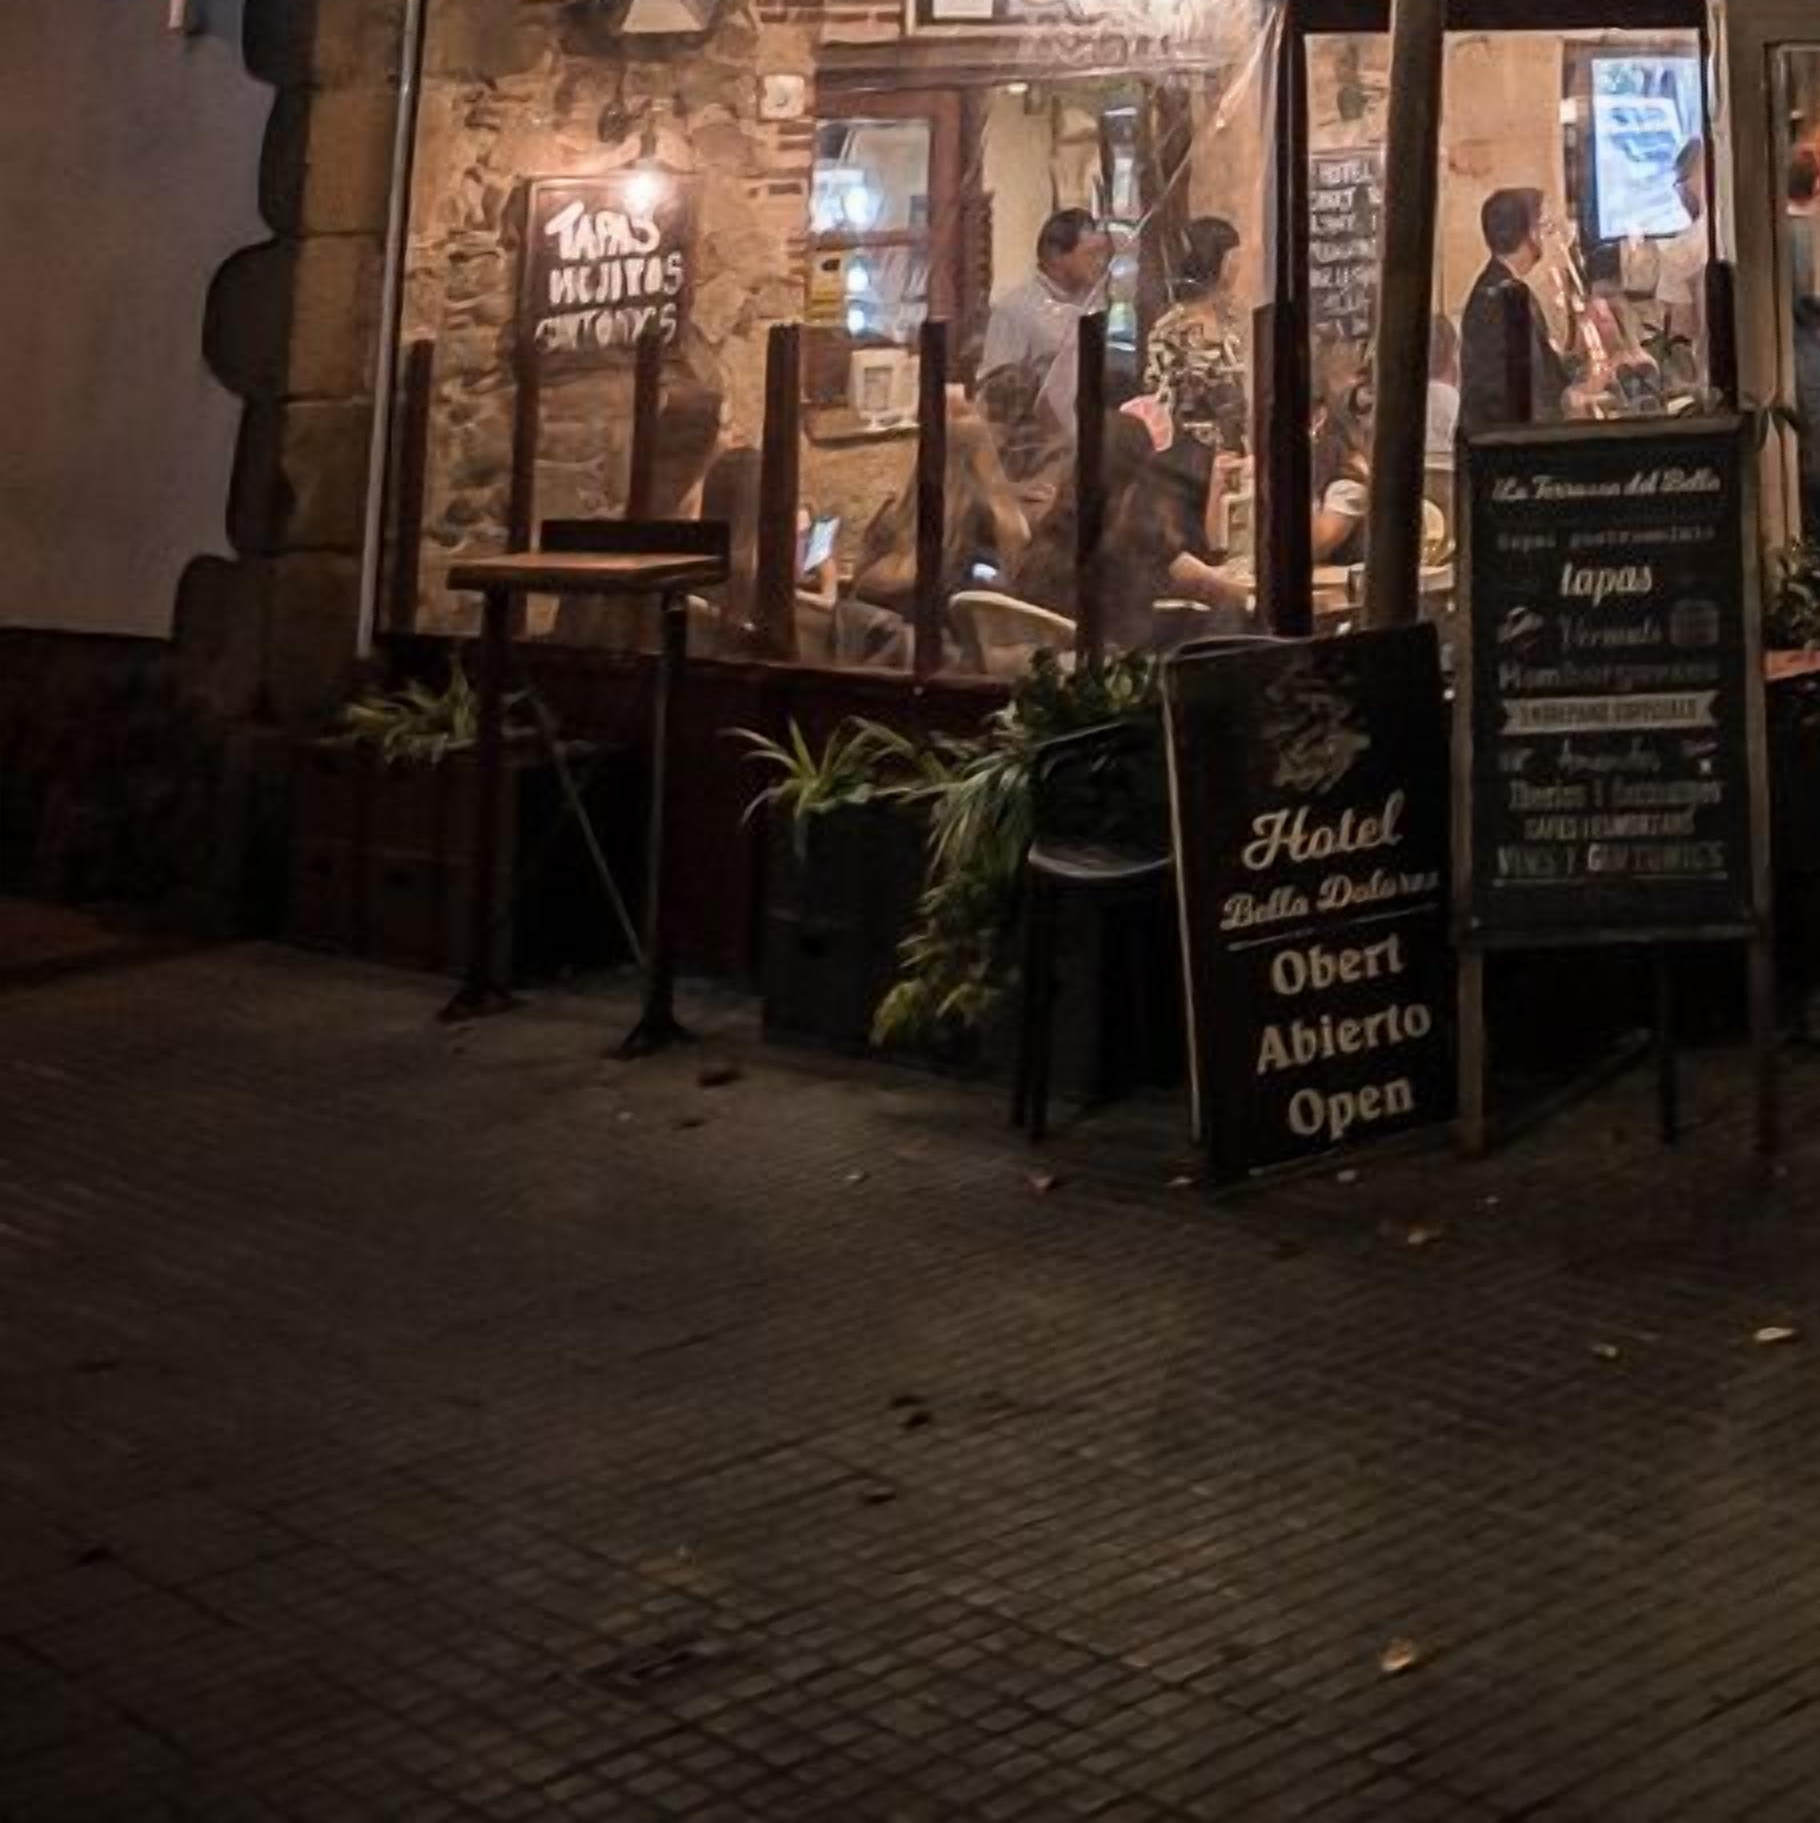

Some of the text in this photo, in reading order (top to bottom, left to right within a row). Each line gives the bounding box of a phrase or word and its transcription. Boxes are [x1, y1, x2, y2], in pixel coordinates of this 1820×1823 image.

[544, 200, 661, 260] TAPAS
[548, 251, 683, 304] MOJITOS
[1242, 790, 1405, 871] Hotel
[1272, 932, 1405, 995] Obert
[1256, 1002, 1432, 1075] Abierto
[1288, 1076, 1414, 1140] Open
